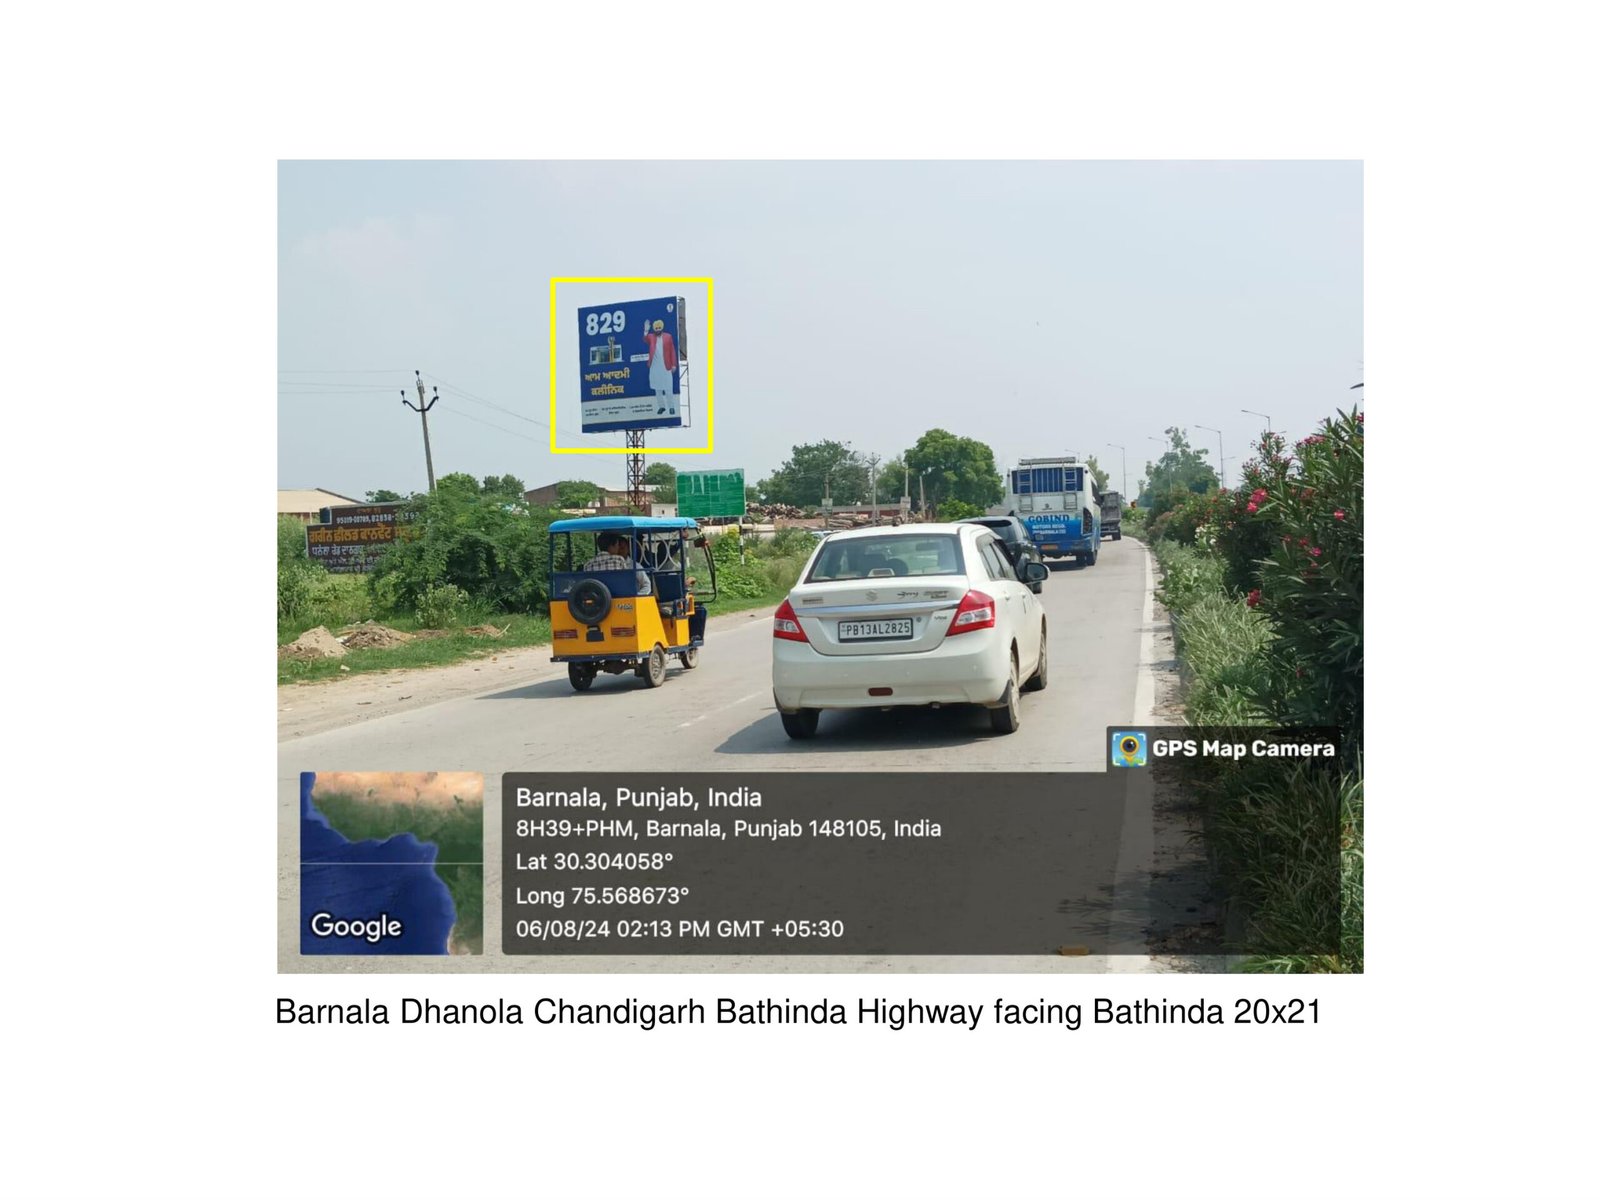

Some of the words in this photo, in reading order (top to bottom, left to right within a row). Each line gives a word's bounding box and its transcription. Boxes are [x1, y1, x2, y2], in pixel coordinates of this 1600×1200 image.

[586, 310, 626, 336] 829
[585, 373, 601, 381] ਆਮ
[602, 367, 631, 379] ਆਦਮੀ
[591, 383, 625, 396] ਕਲੀਨਿਕ
[1028, 514, 1070, 523] GOBIND
[846, 621, 910, 636] PB13AL2825
